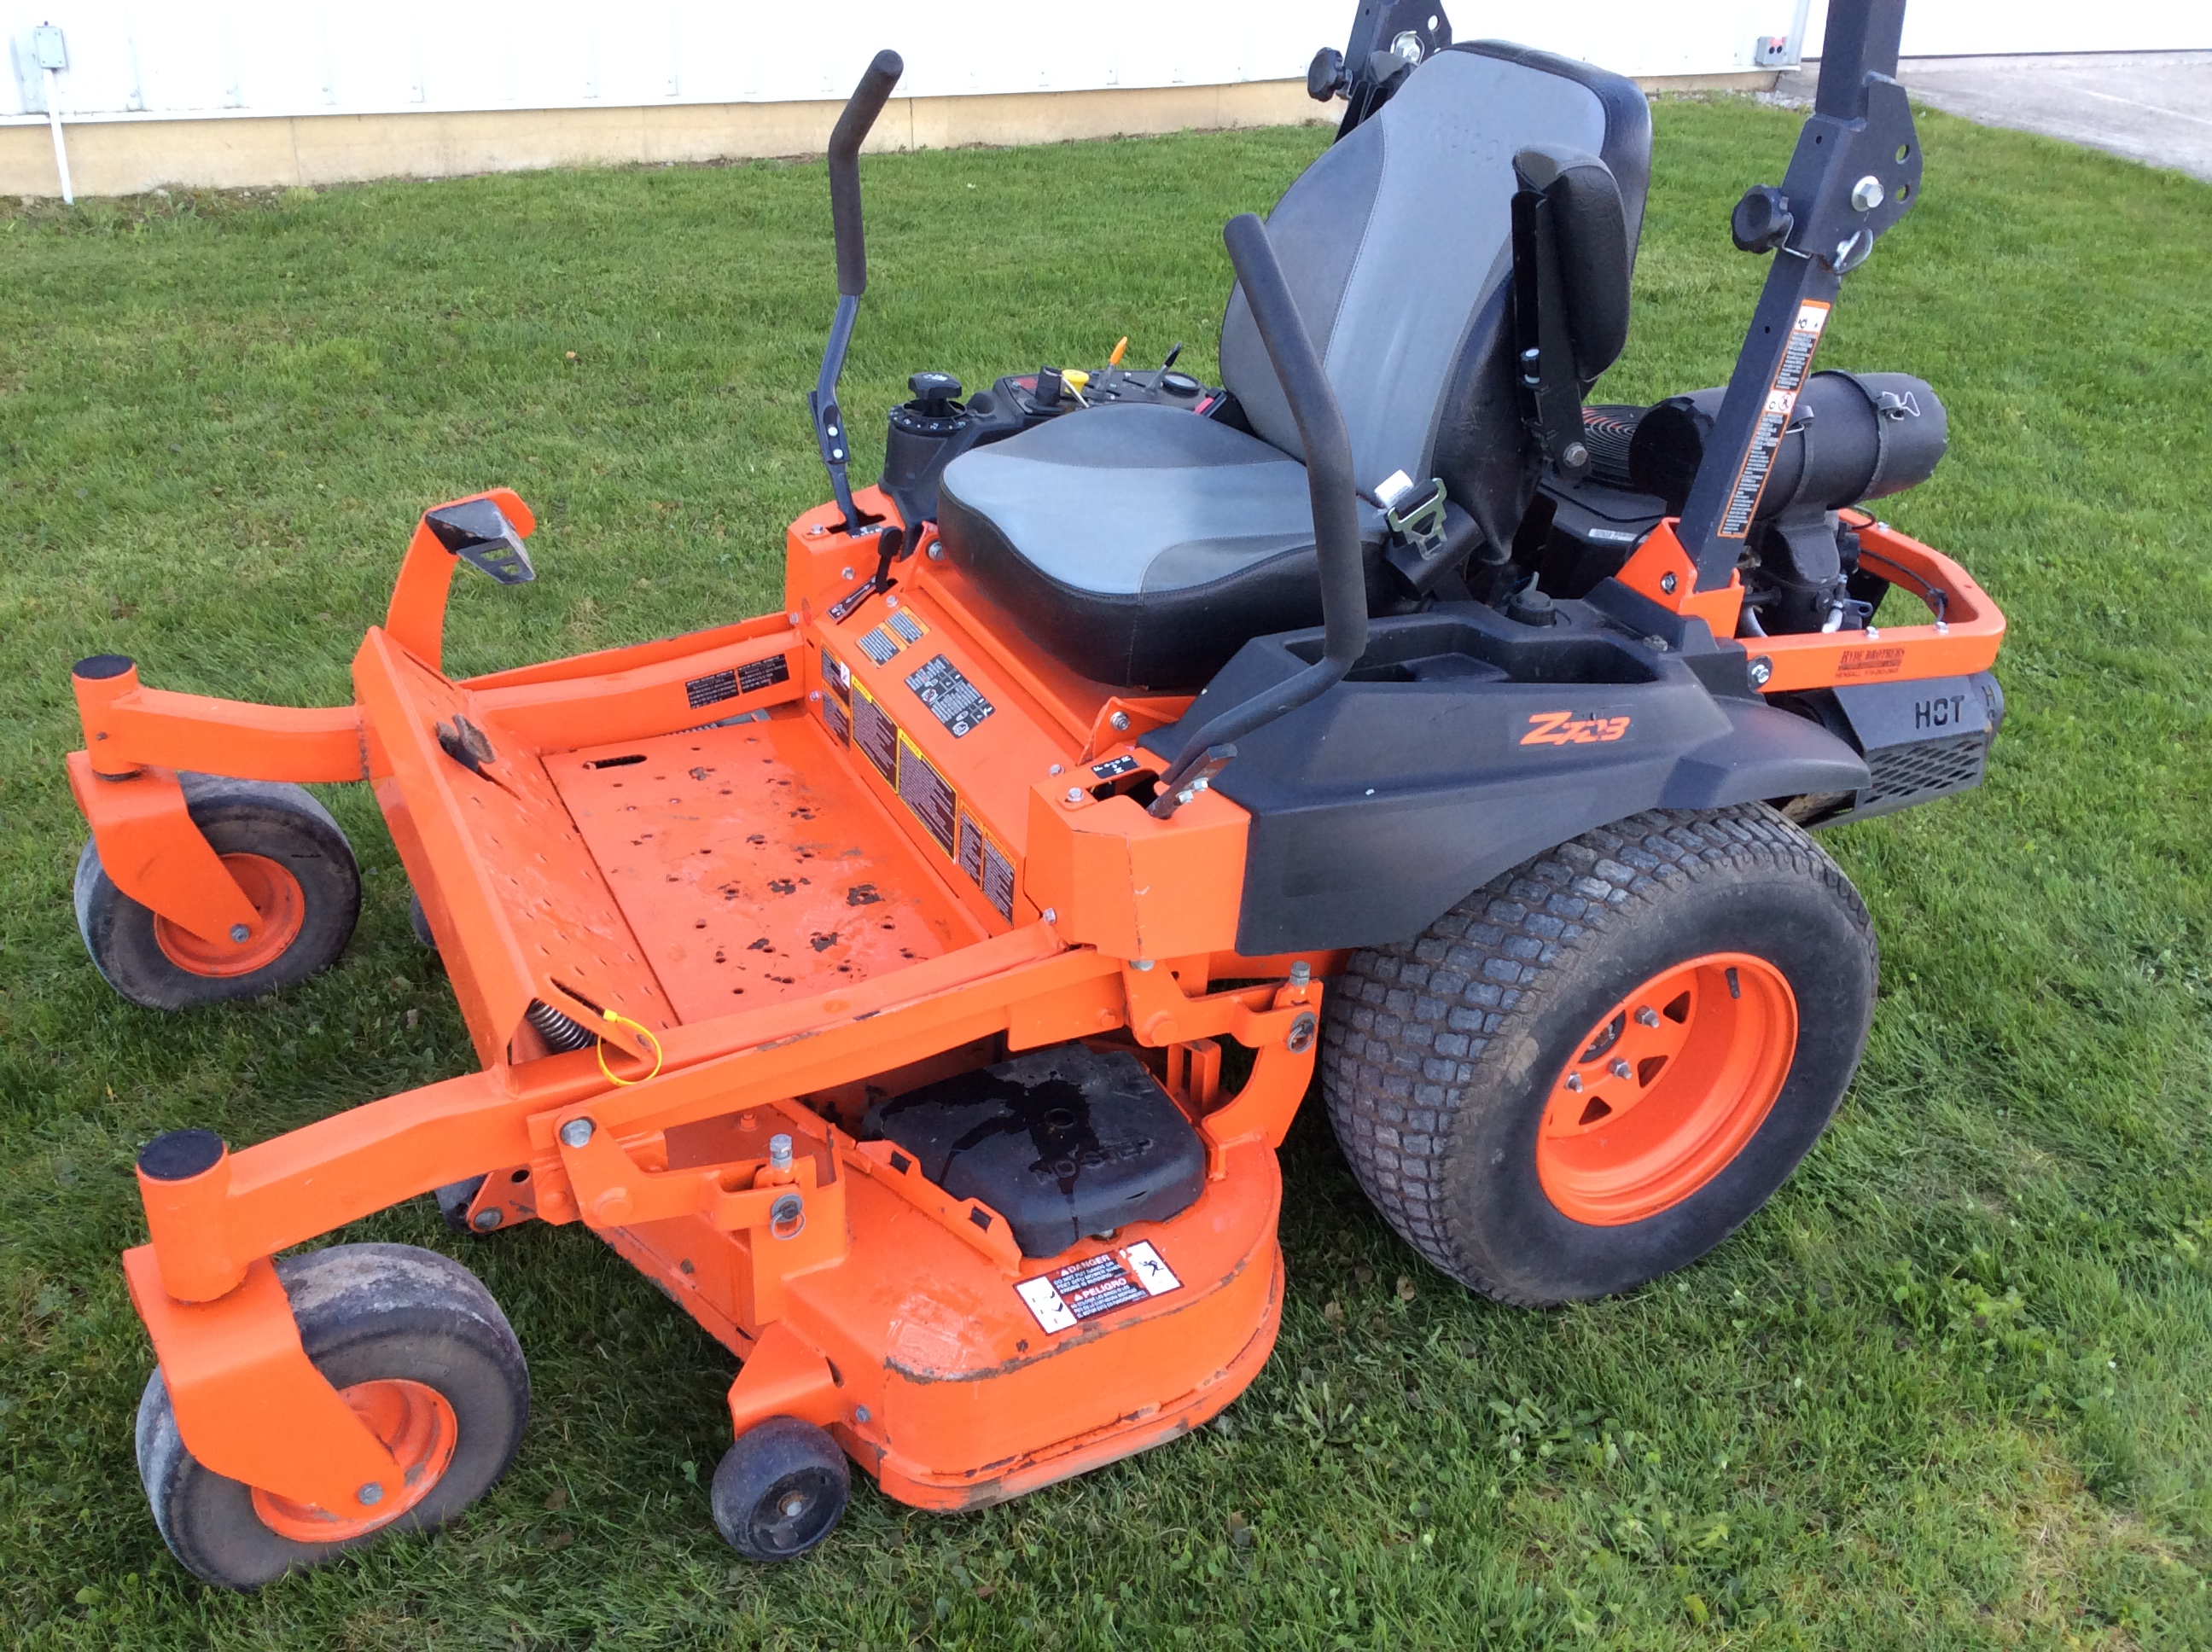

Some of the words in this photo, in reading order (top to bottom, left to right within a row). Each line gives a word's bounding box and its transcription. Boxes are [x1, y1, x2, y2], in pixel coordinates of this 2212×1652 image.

[1915, 695, 1965, 729] HOT
[1031, 1158, 1077, 1185] NO
[1068, 1254, 1111, 1273] DANGER
[1082, 1277, 1126, 1298] PELIGRO
